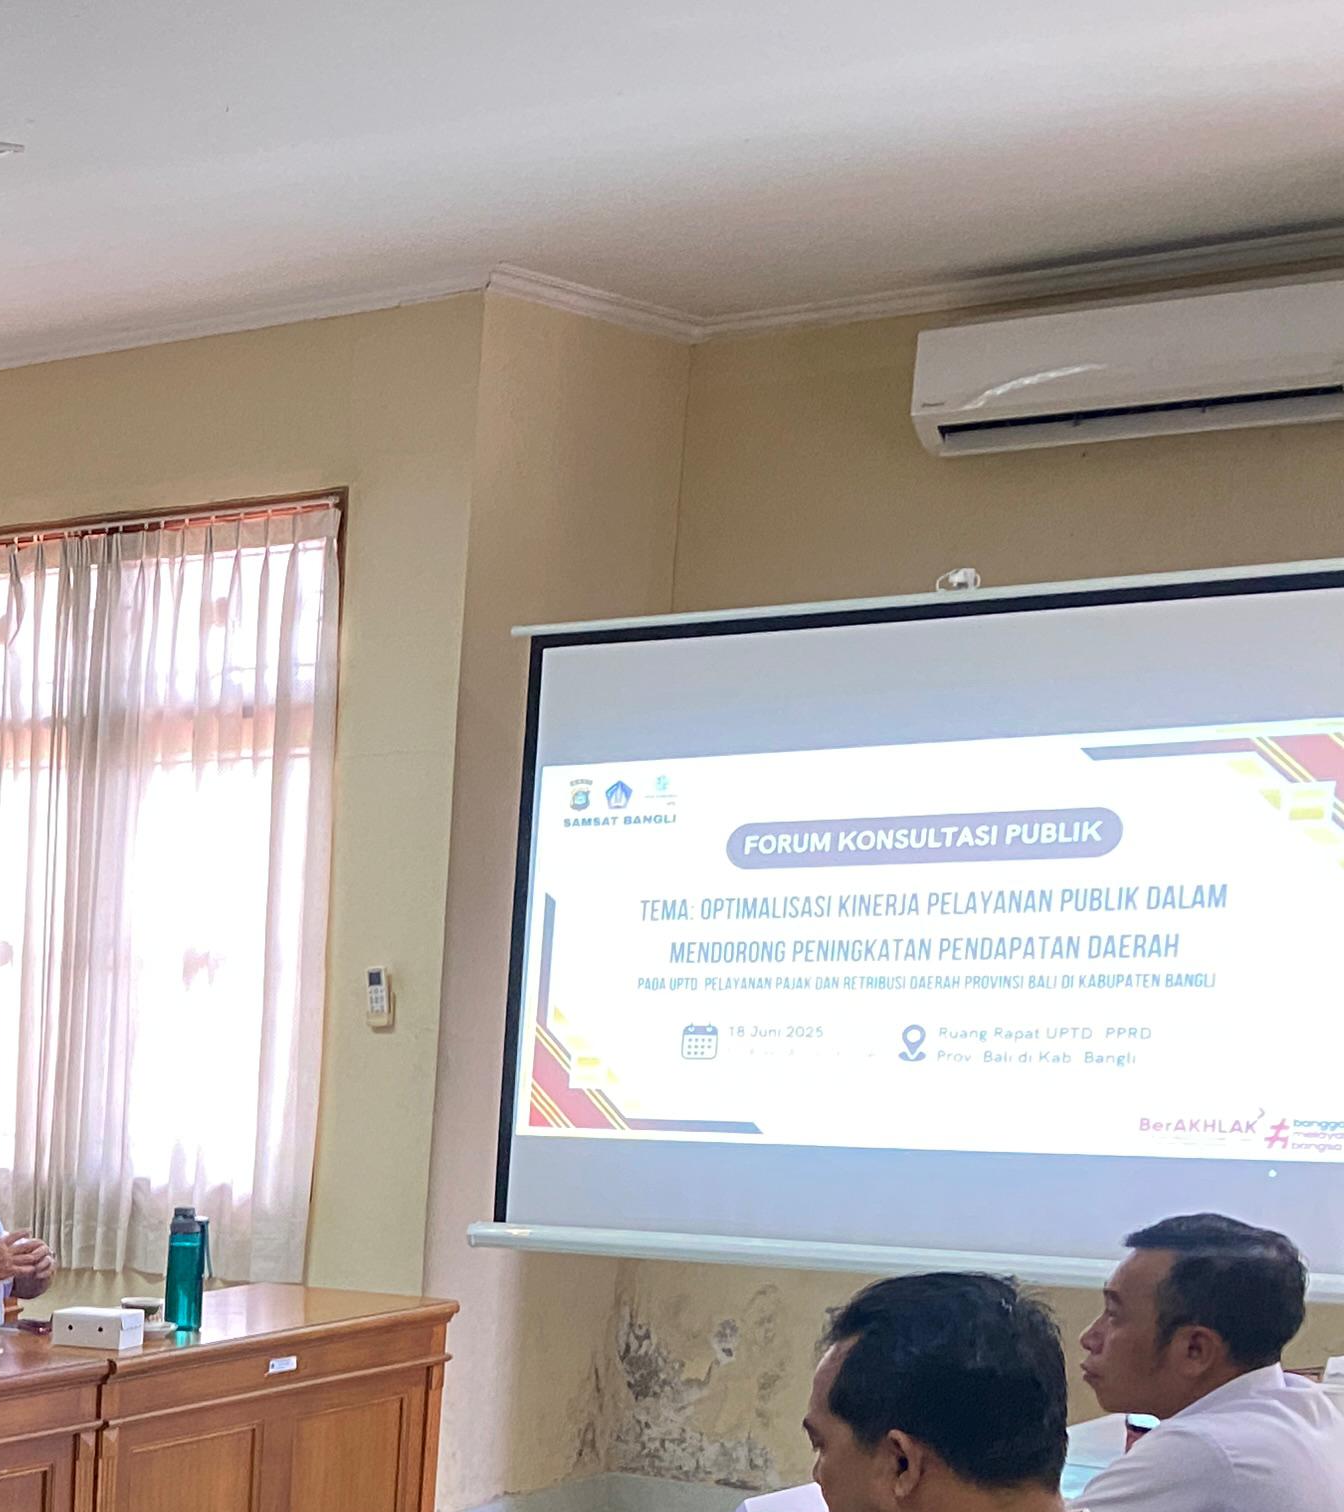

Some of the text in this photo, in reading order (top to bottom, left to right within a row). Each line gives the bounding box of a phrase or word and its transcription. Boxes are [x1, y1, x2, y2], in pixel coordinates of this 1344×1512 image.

[564, 814, 676, 827] SAMSAT BANGLI
[744, 821, 1103, 854] FORUM KONSULTASI PUBLIK
[640, 884, 1228, 921] TEMA: OPTIMALISASI KINERJA PELAYANAN PUBLIK DALAM
[669, 933, 1180, 963] MENDORONG PENINGKATAN PENDAPATAN DAERAH
[637, 977, 666, 990] PADA
[704, 977, 772, 991] PELAYANAN
[775, 977, 811, 990] PAJAK
[815, 977, 839, 990] DAN
[843, 976, 905, 990] RETRIBUSI
[910, 975, 960, 989] DAERAH
[964, 975, 1024, 989] PROVINSI
[1028, 975, 1057, 989] BALI
[1062, 974, 1074, 989] DI
[1078, 973, 1160, 988] KABUPATEN
[1165, 973, 1216, 988] BANGLI
[728, 1026, 824, 1038] 18 Juni 2025
[939, 1027, 987, 1041] Ruang
[994, 1027, 1039, 1042] Rapat
[1105, 1027, 1152, 1040] PPRD
[983, 1050, 1012, 1063] Bali
[1018, 1051, 1032, 1063] di
[1084, 1051, 1136, 1067] Bangli
[1139, 1118, 1257, 1134] BerAKHLAK
